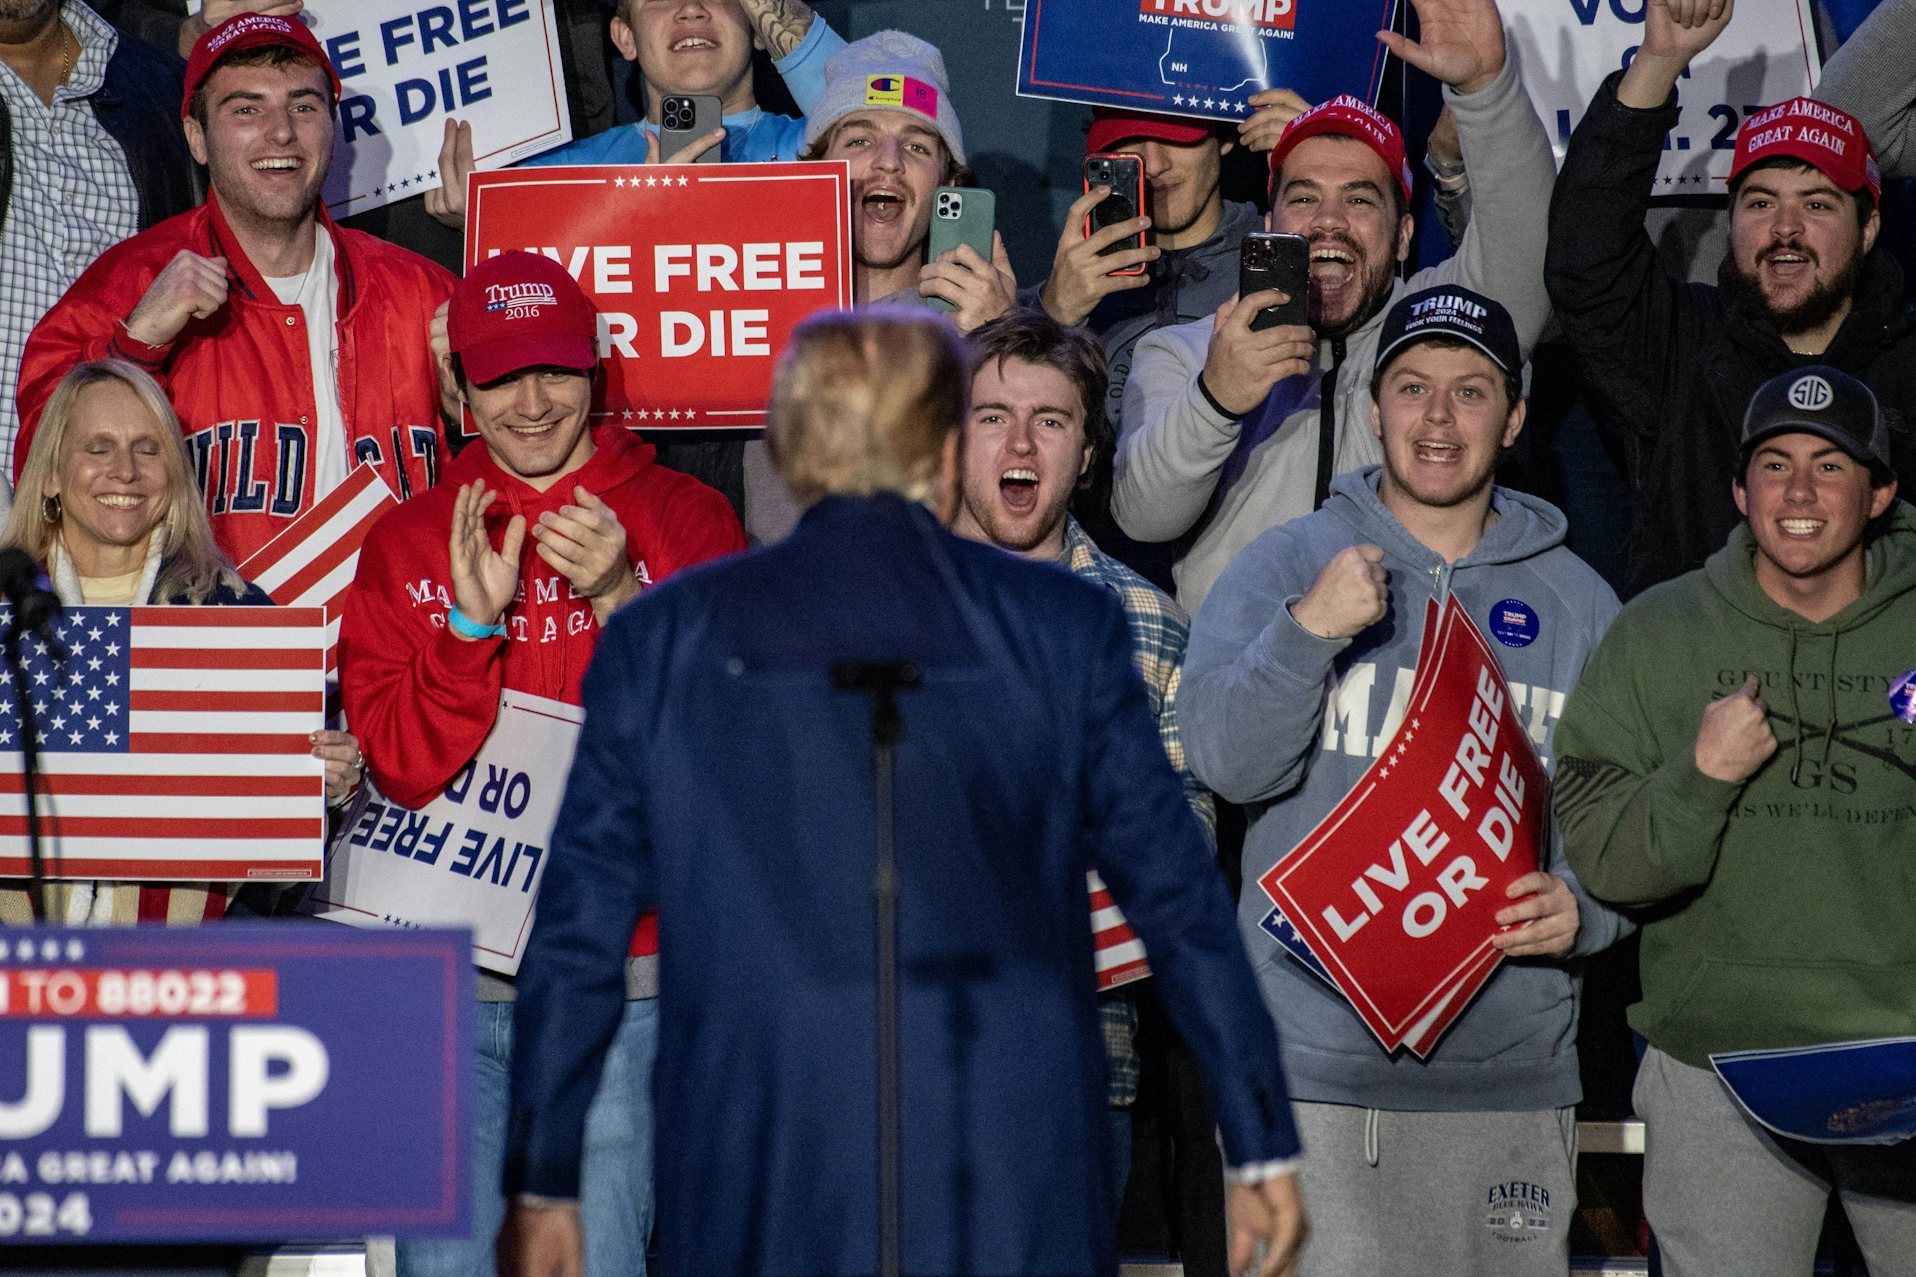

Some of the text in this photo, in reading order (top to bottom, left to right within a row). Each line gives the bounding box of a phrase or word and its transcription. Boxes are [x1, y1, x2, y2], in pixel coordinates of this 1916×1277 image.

[380, 0, 530, 66] FREE
[1139, 14, 1295, 40] MAKE AMERICA GRET AGAIN!
[1171, 62, 1187, 72] NH
[339, 94, 381, 143] R
[395, 55, 492, 126] DIE
[1291, 95, 1394, 136] MAKE AMERICA
[1745, 100, 1854, 136] MAKE AMERICA
[1748, 126, 1846, 155] GREAT AGAIN
[488, 241, 825, 294] VE FREE
[485, 283, 554, 304] Trump
[1410, 295, 1488, 319] TRUMP
[505, 305, 540, 320] 2016
[1434, 308, 1457, 317] 2024
[596, 309, 770, 358] R DIE
[1791, 377, 1831, 408] SIG
[406, 578, 526, 608] MAE
[479, 763, 531, 819] OR
[1791, 759, 1858, 795] GS
[1322, 808, 1450, 943] LIVE
[1438, 664, 1504, 821] FREE
[349, 802, 544, 893] LIVE FREE
[1402, 752, 1525, 938] OR DIE
[20, 970, 87, 1015] TO
[97, 970, 246, 1015] 88022
[37, 1152, 158, 1184] GREAT
[1488, 1181, 1549, 1207] EXETER
